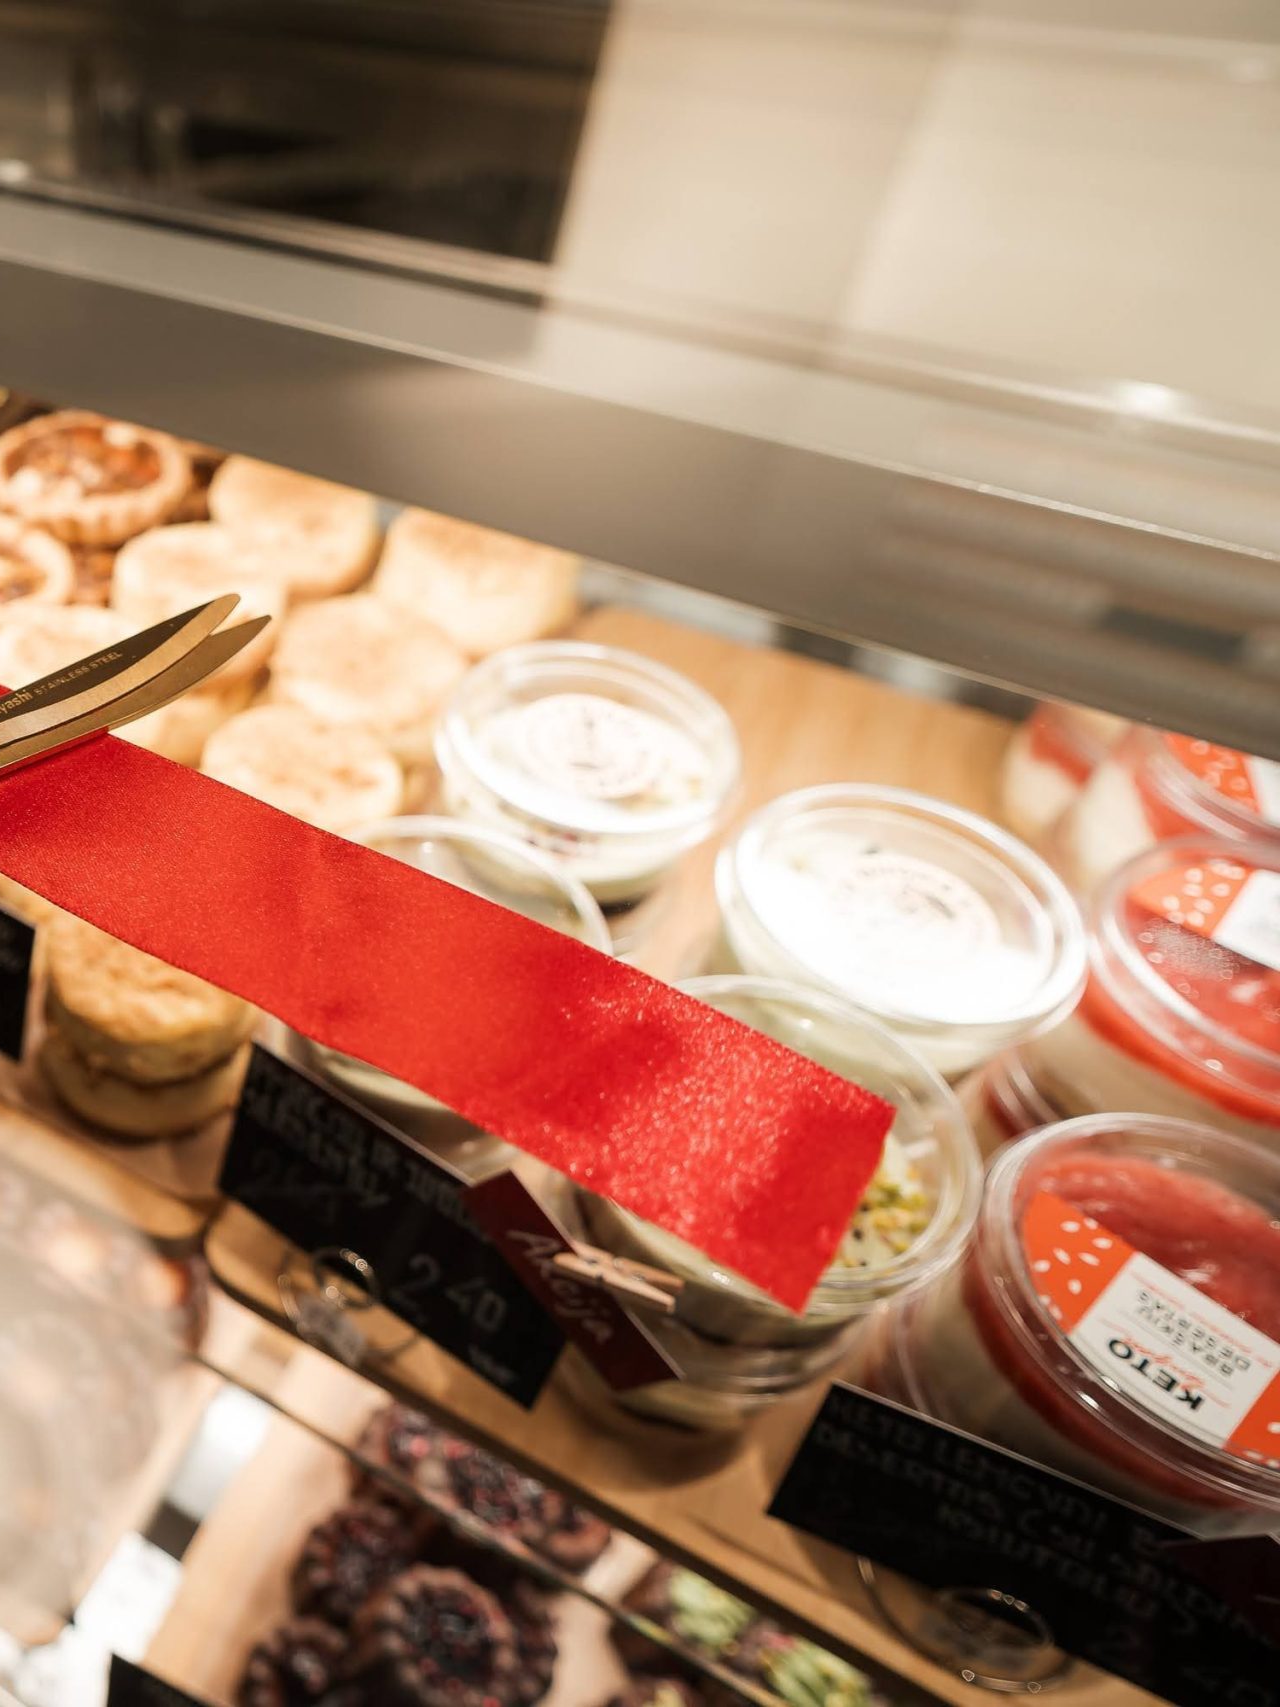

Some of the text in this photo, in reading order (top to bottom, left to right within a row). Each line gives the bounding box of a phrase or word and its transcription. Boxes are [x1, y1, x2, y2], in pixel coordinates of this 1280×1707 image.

[34, 664, 90, 696] STAINLESS
[90, 650, 122, 671] STEEL
[1106, 1338, 1204, 1412] KETO
